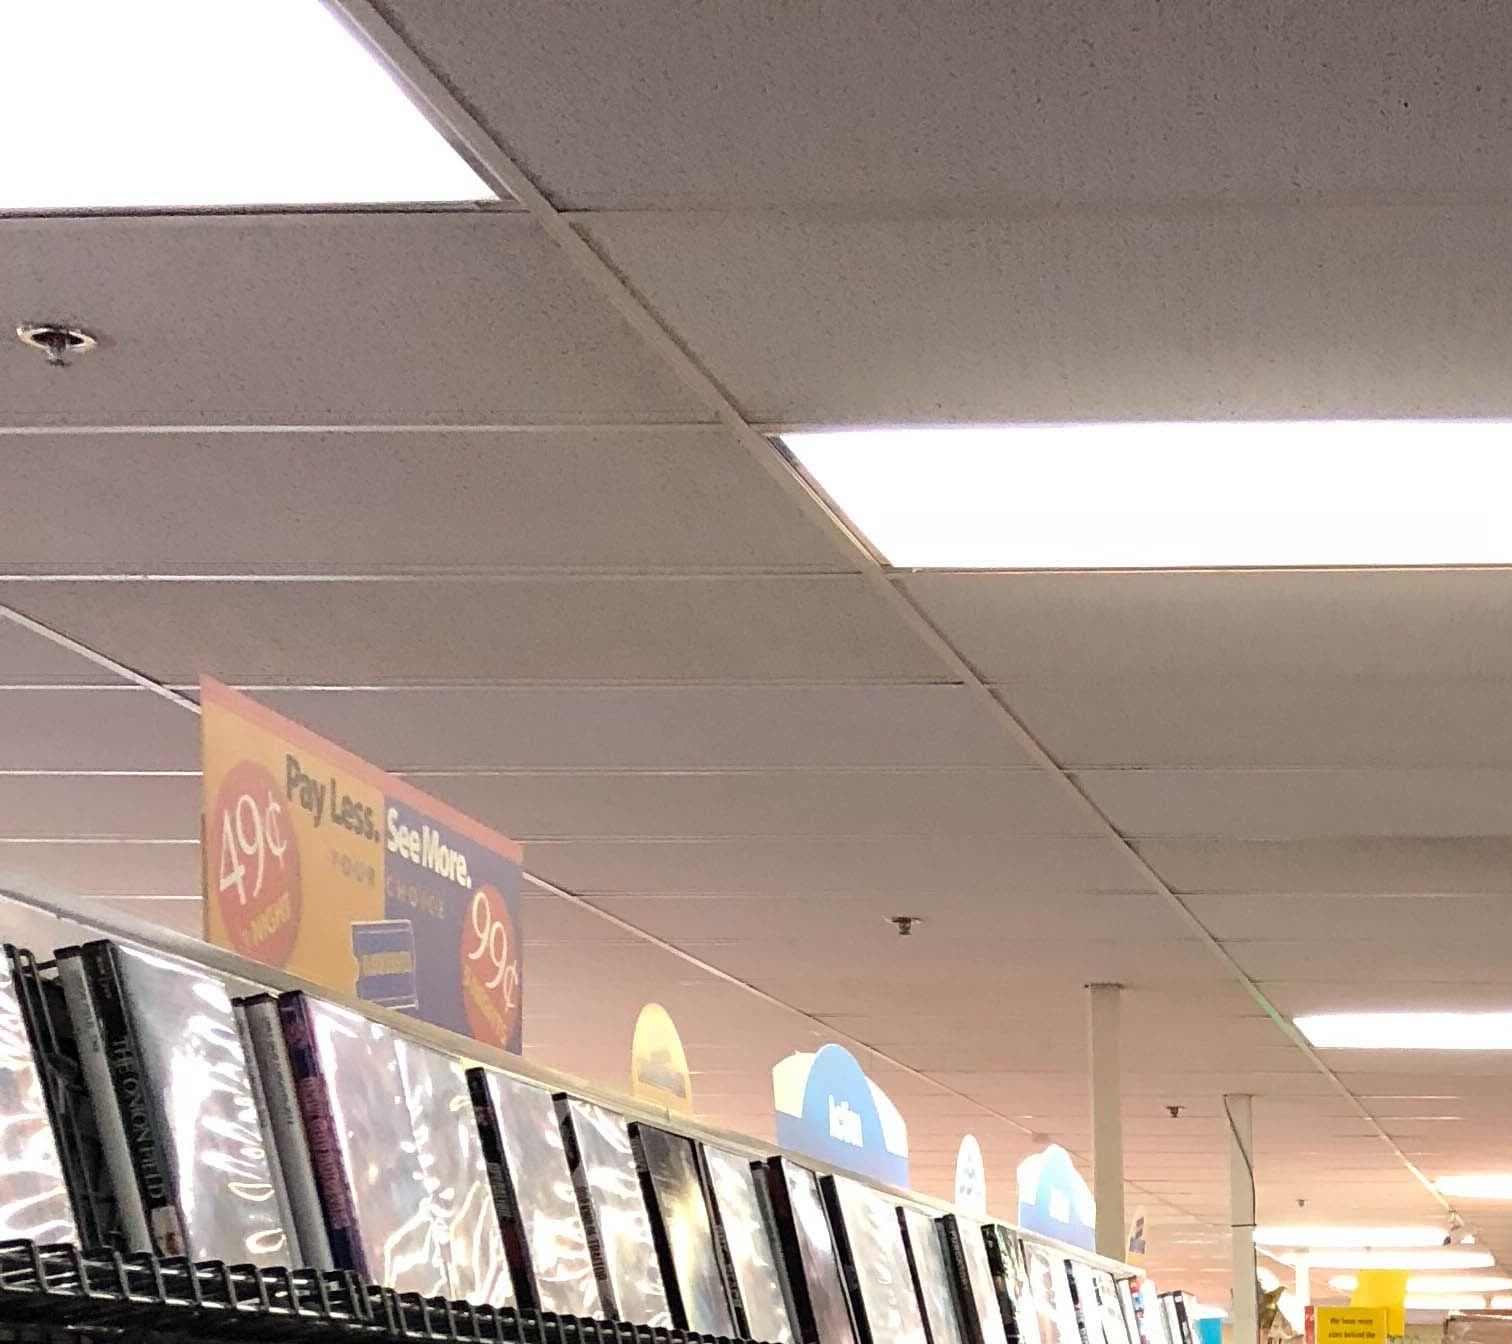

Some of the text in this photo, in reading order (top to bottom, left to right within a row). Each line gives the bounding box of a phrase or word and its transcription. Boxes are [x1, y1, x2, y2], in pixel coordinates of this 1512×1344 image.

[286, 753, 381, 843] Pay Less.
[387, 806, 472, 889] See More.
